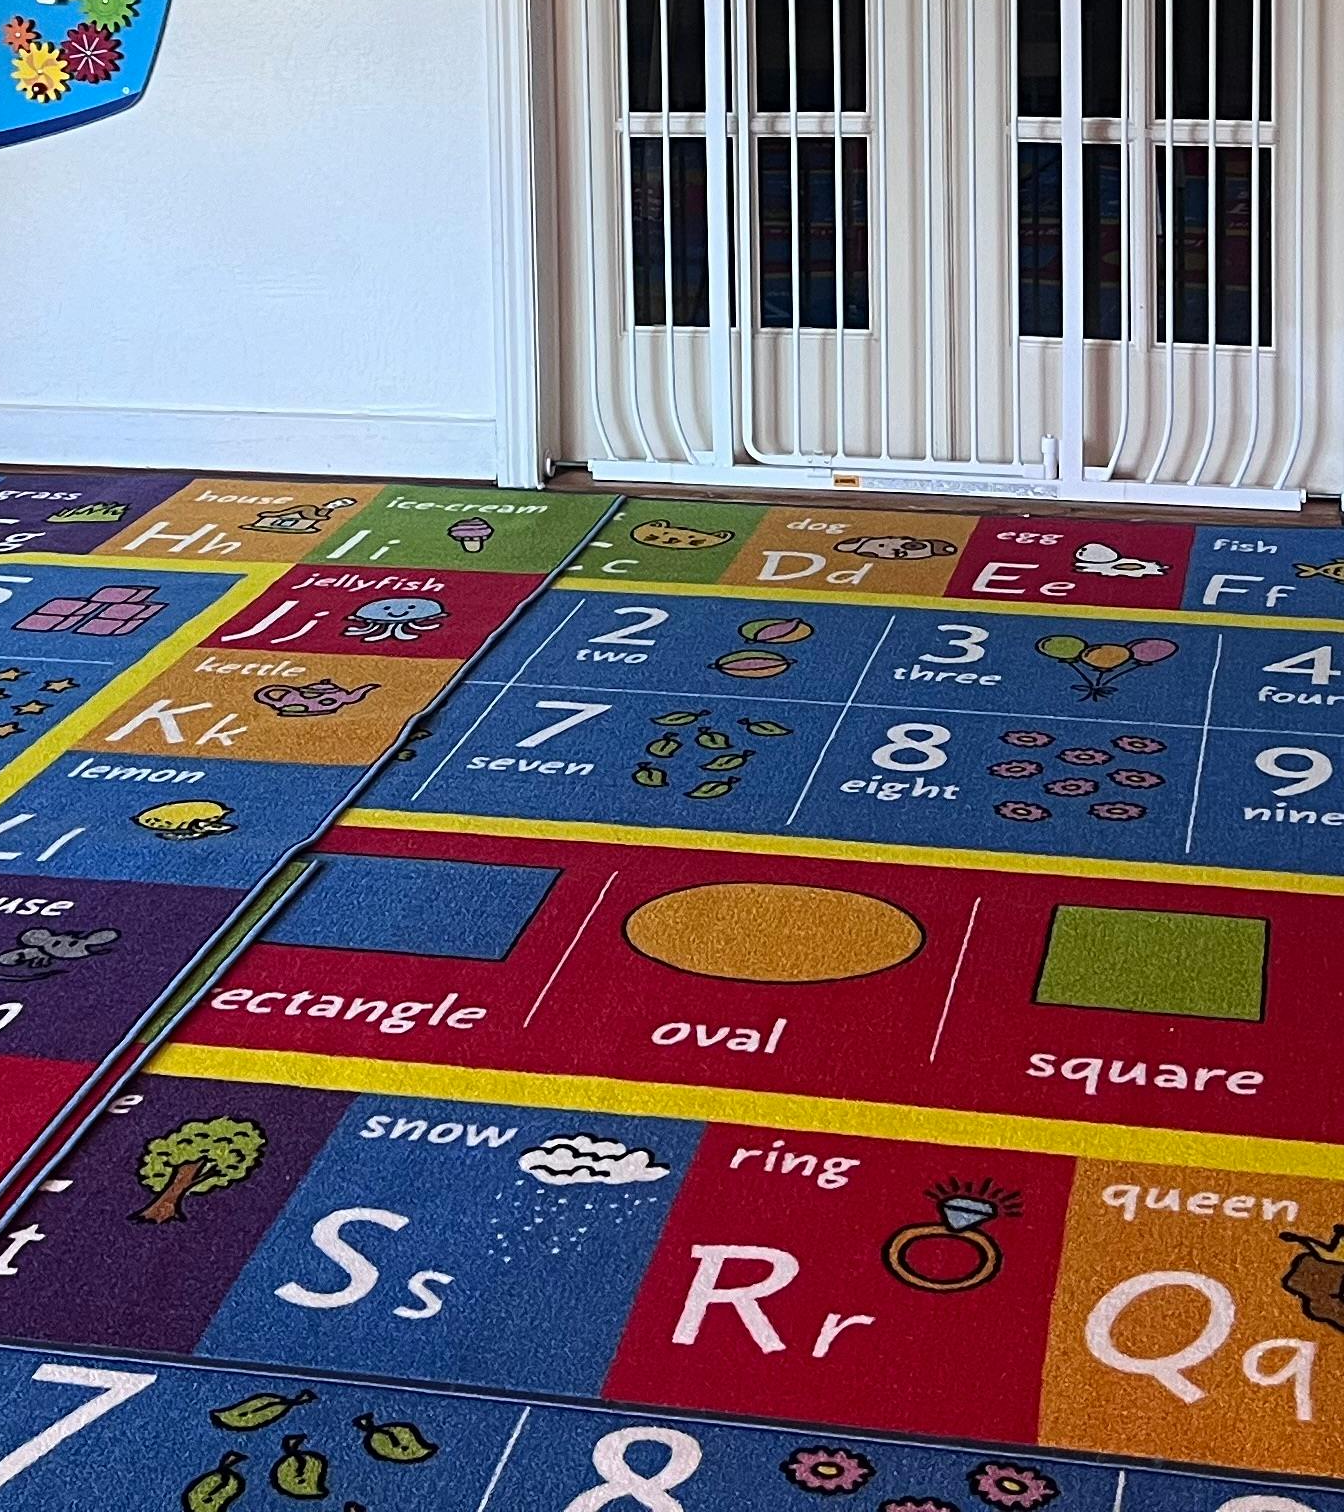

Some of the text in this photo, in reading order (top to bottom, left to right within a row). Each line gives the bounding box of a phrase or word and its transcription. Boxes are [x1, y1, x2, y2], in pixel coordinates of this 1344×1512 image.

[195, 490, 293, 504] house
[387, 497, 547, 513] ice-cream
[787, 518, 850, 534] dog
[997, 528, 1064, 545] egg
[1214, 539, 1277, 553] fish
[292, 574, 444, 591] jellyfish
[588, 607, 669, 645] 2
[577, 649, 647, 663] two
[919, 625, 989, 663] 3
[194, 657, 306, 677] kettle
[894, 665, 1001, 685] three
[1263, 646, 1341, 684] 4
[516, 701, 612, 747] 7
[872, 723, 950, 771] 8
[68, 758, 205, 783] lemon
[467, 757, 594, 775] seven
[1255, 747, 1332, 796] 9
[840, 775, 959, 800] eight
[1244, 802, 1344, 825] nine
[211, 985, 486, 1033] ectangle
[652, 1018, 787, 1053] oval
[1026, 1048, 1263, 1095] square
[360, 1109, 518, 1151] snow
[730, 1140, 860, 1189] ring
[1102, 1180, 1299, 1221] queen
